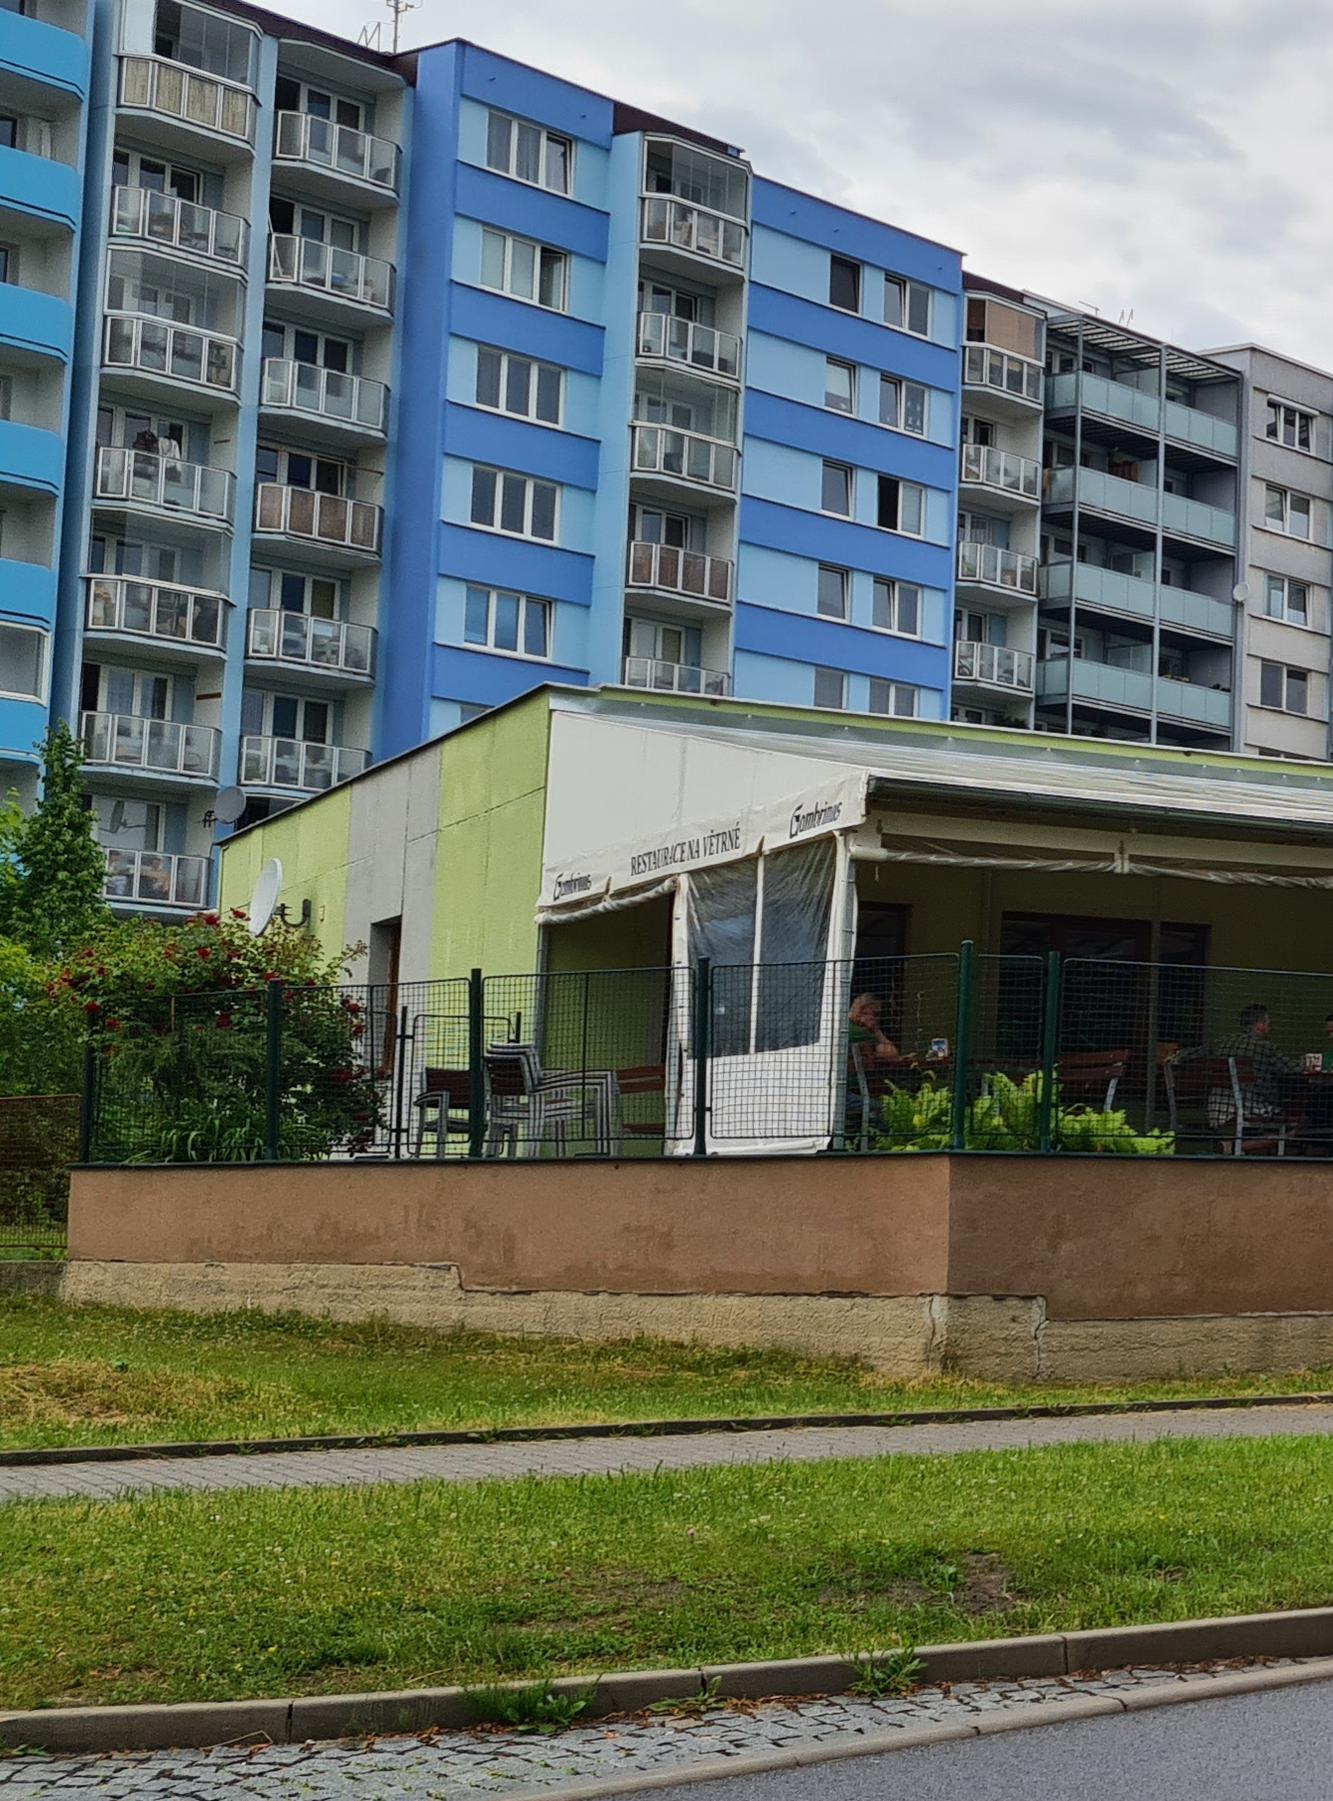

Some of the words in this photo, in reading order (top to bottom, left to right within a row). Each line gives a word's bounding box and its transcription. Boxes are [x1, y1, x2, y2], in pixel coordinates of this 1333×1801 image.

[631, 842, 686, 876] RESTAURACE
[687, 841, 700, 862] NA
[702, 822, 741, 858] VĚTRNÉ
